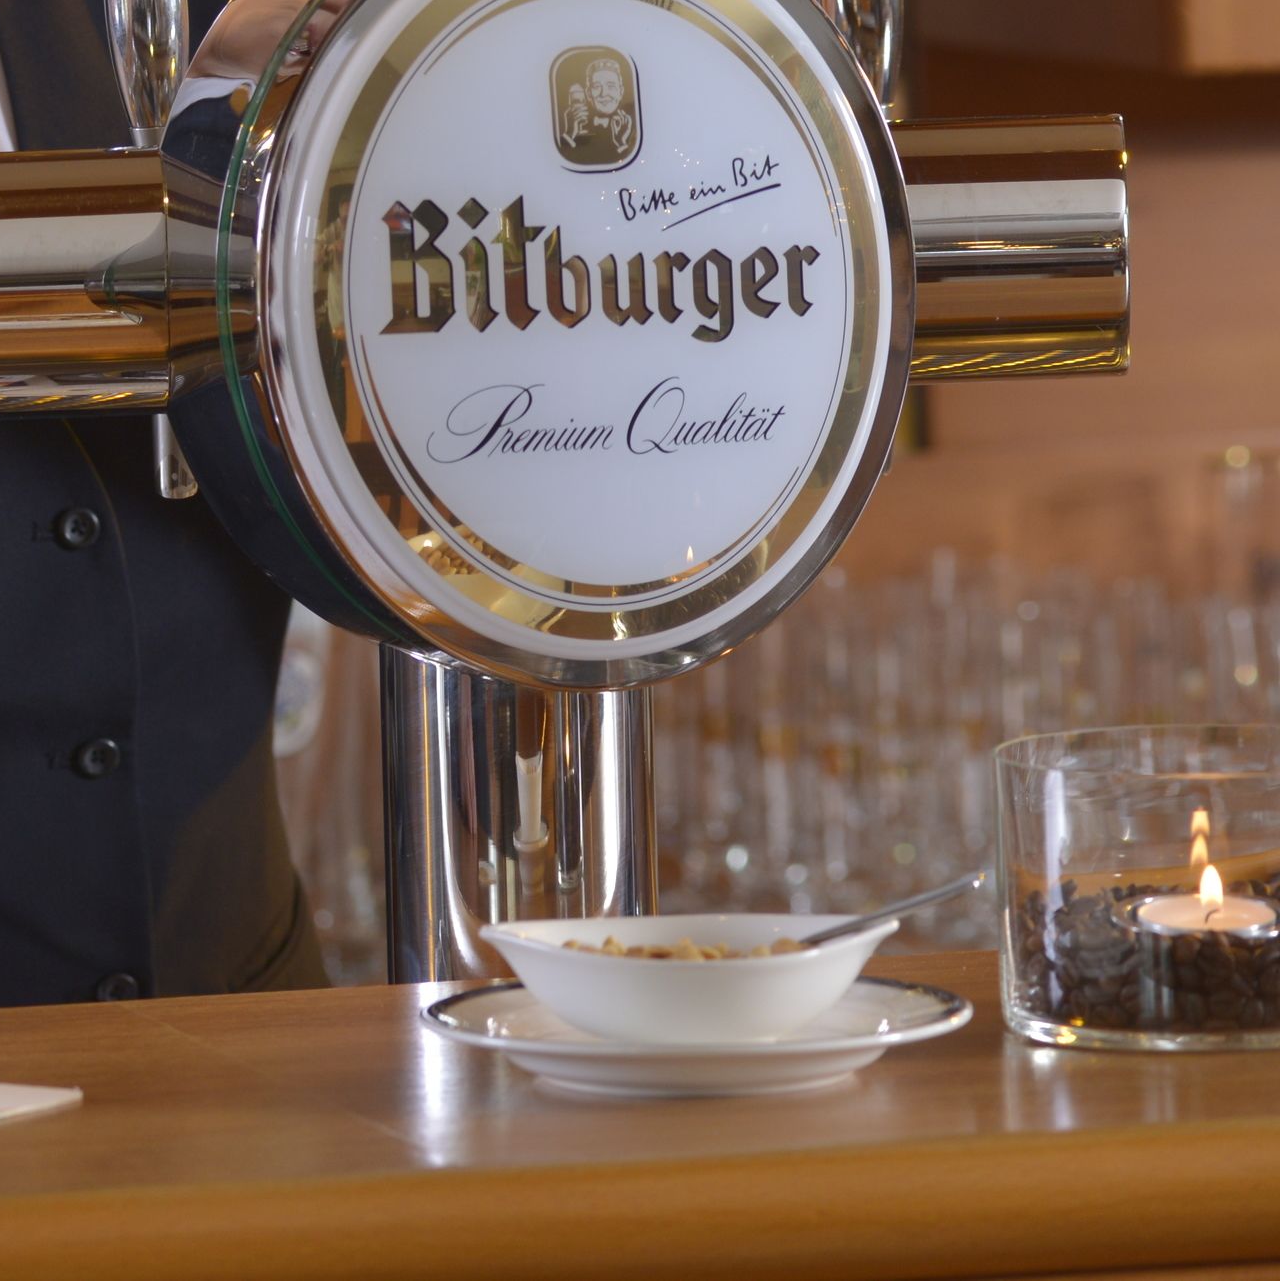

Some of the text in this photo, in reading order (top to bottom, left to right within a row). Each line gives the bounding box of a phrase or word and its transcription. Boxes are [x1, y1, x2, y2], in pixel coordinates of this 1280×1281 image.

[619, 154, 780, 221] Bitte ein Bit
[378, 194, 822, 344] Bitburger
[426, 375, 786, 464] Premium Qualität
